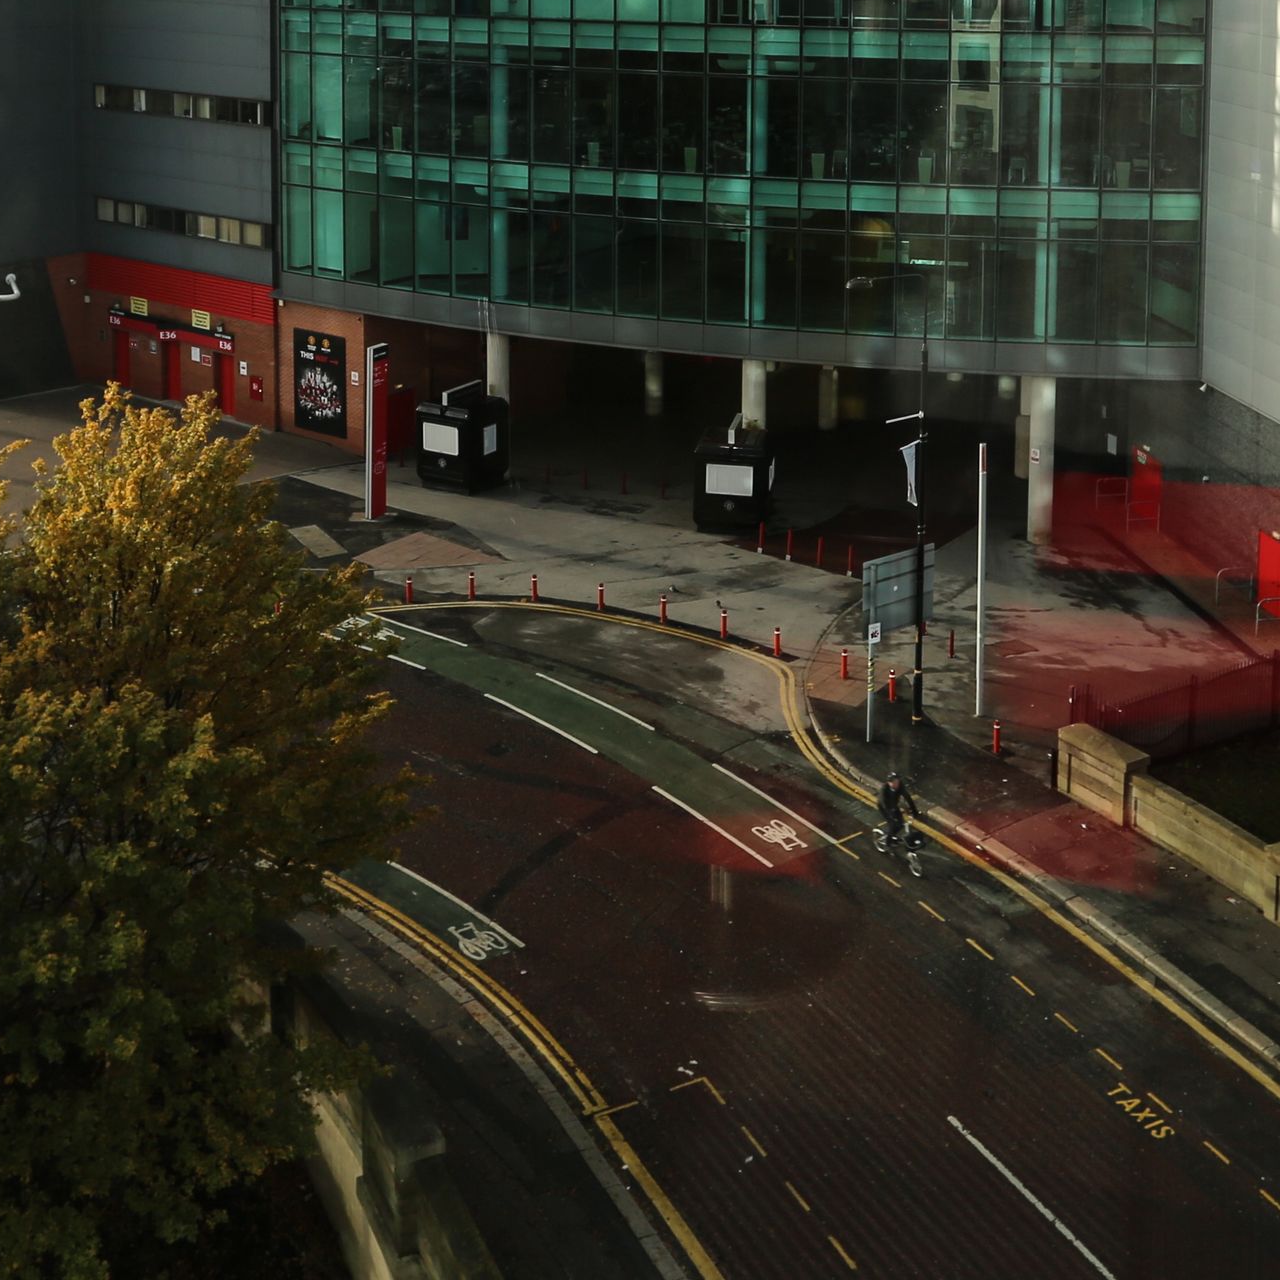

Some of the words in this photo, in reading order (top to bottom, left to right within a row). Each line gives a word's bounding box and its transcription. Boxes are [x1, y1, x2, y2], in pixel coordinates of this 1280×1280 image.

[110, 316, 121, 325] E36
[160, 331, 177, 339] E36
[219, 340, 232, 351] E36
[300, 350, 314, 360] THIS
[1107, 1082, 1175, 1139] TAXIS
